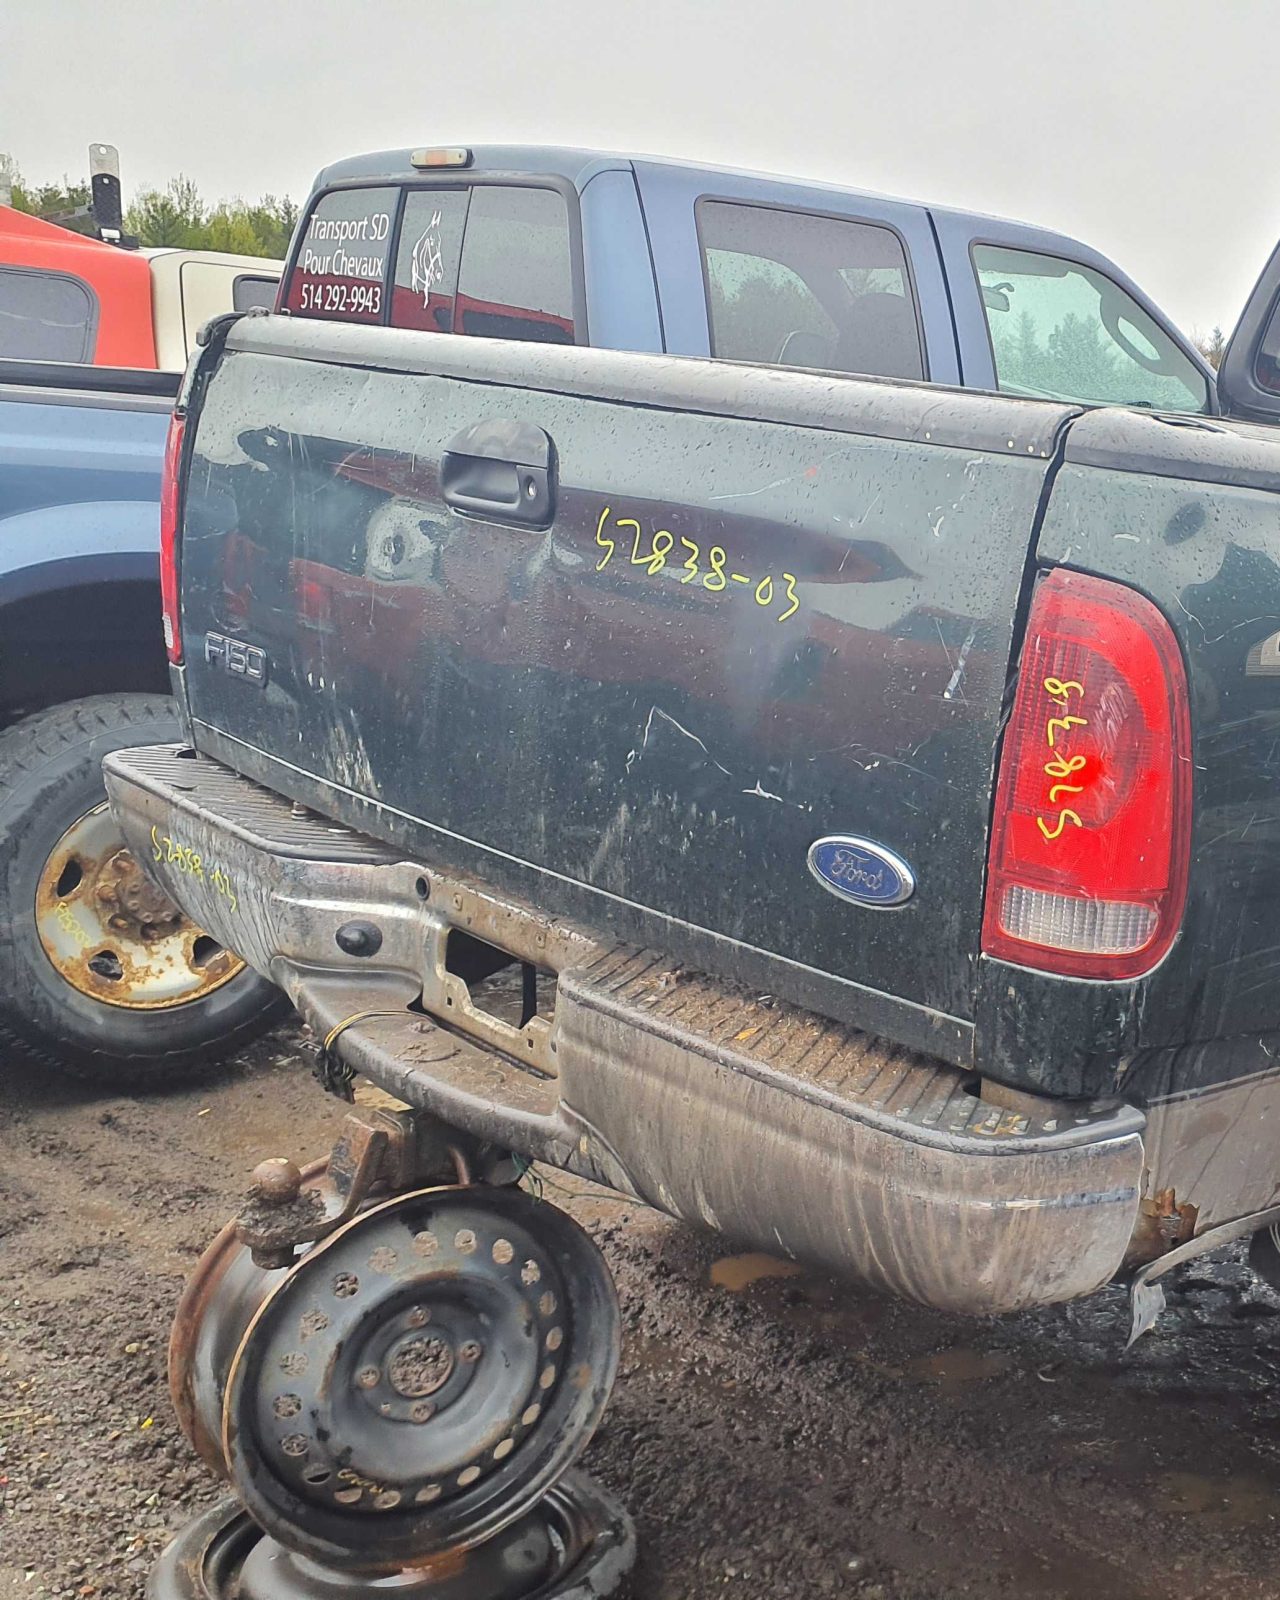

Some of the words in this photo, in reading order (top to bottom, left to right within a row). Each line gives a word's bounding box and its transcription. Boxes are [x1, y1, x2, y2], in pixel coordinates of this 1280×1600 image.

[310, 214, 368, 246] Transport
[369, 213, 390, 241] SD
[303, 248, 331, 275] Pour
[332, 248, 384, 277] Chevaux
[300, 283, 323, 309] 514
[324, 284, 381, 313] 292-9943
[830, 848, 884, 891] Ford
